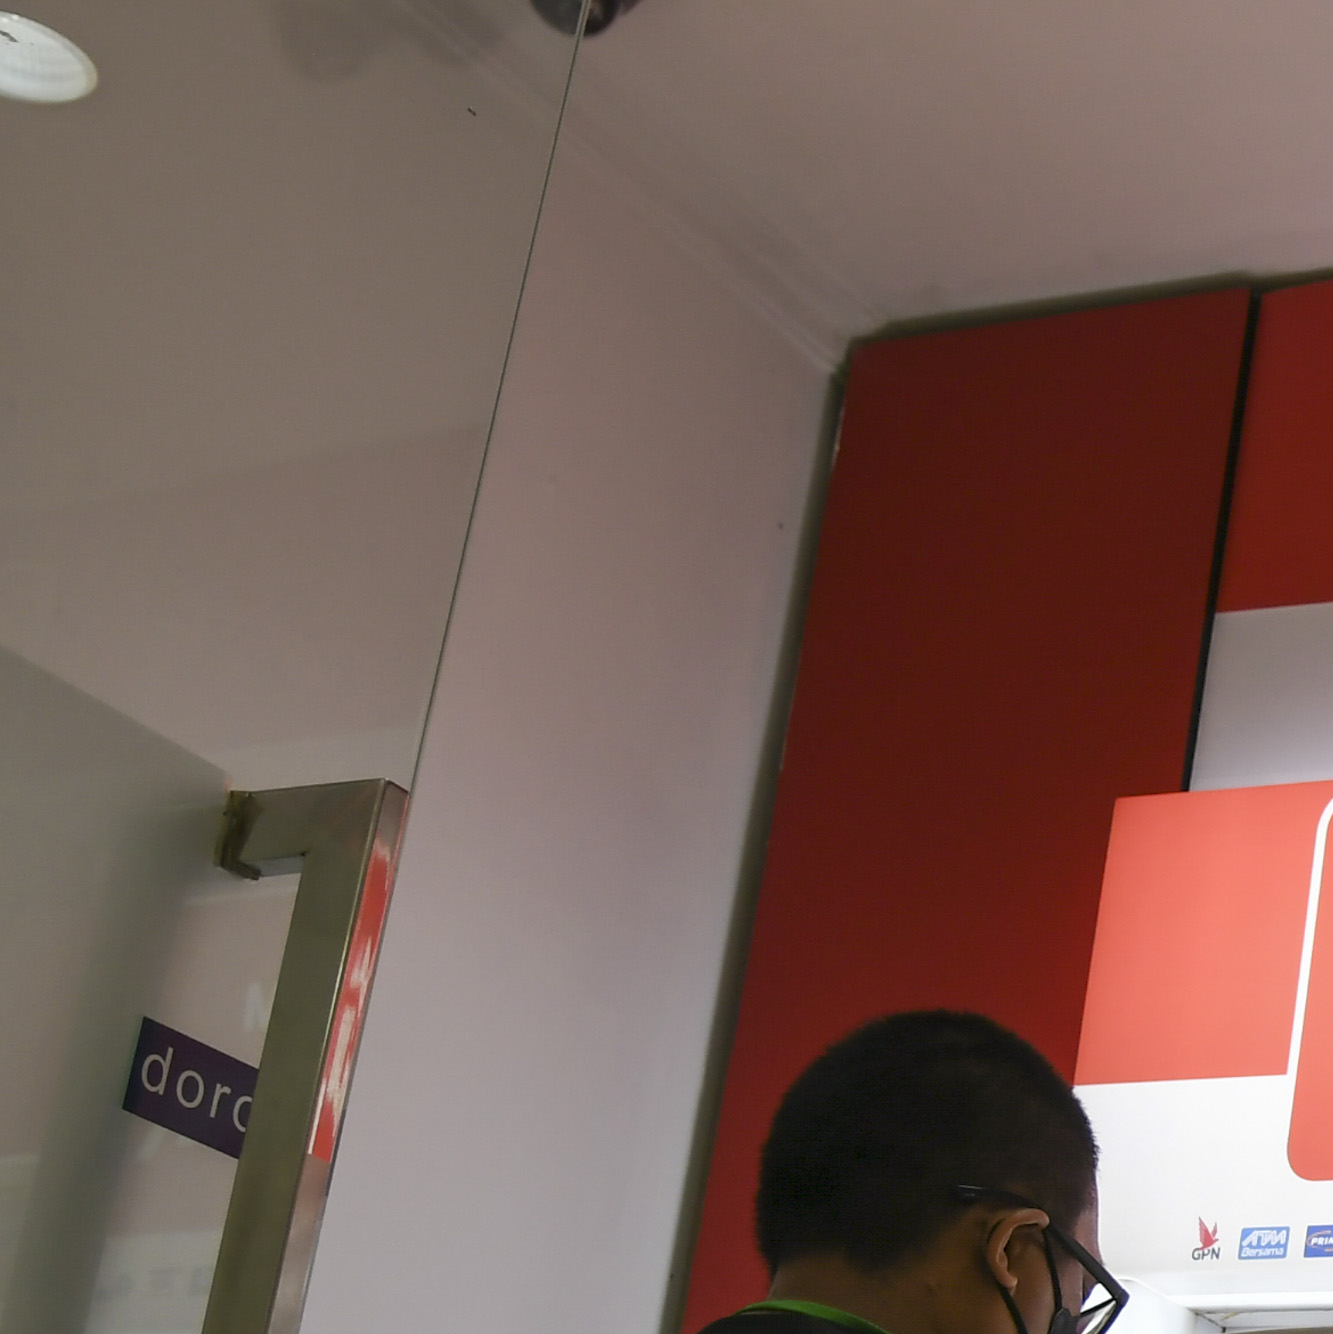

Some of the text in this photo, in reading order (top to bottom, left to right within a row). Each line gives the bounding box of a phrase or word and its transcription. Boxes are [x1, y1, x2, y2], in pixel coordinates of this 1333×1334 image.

[141, 1046, 254, 1134] doro
[1241, 1229, 1287, 1247] ATM
[1191, 1246, 1221, 1261] GPN
[1240, 1246, 1285, 1258] Bersama
